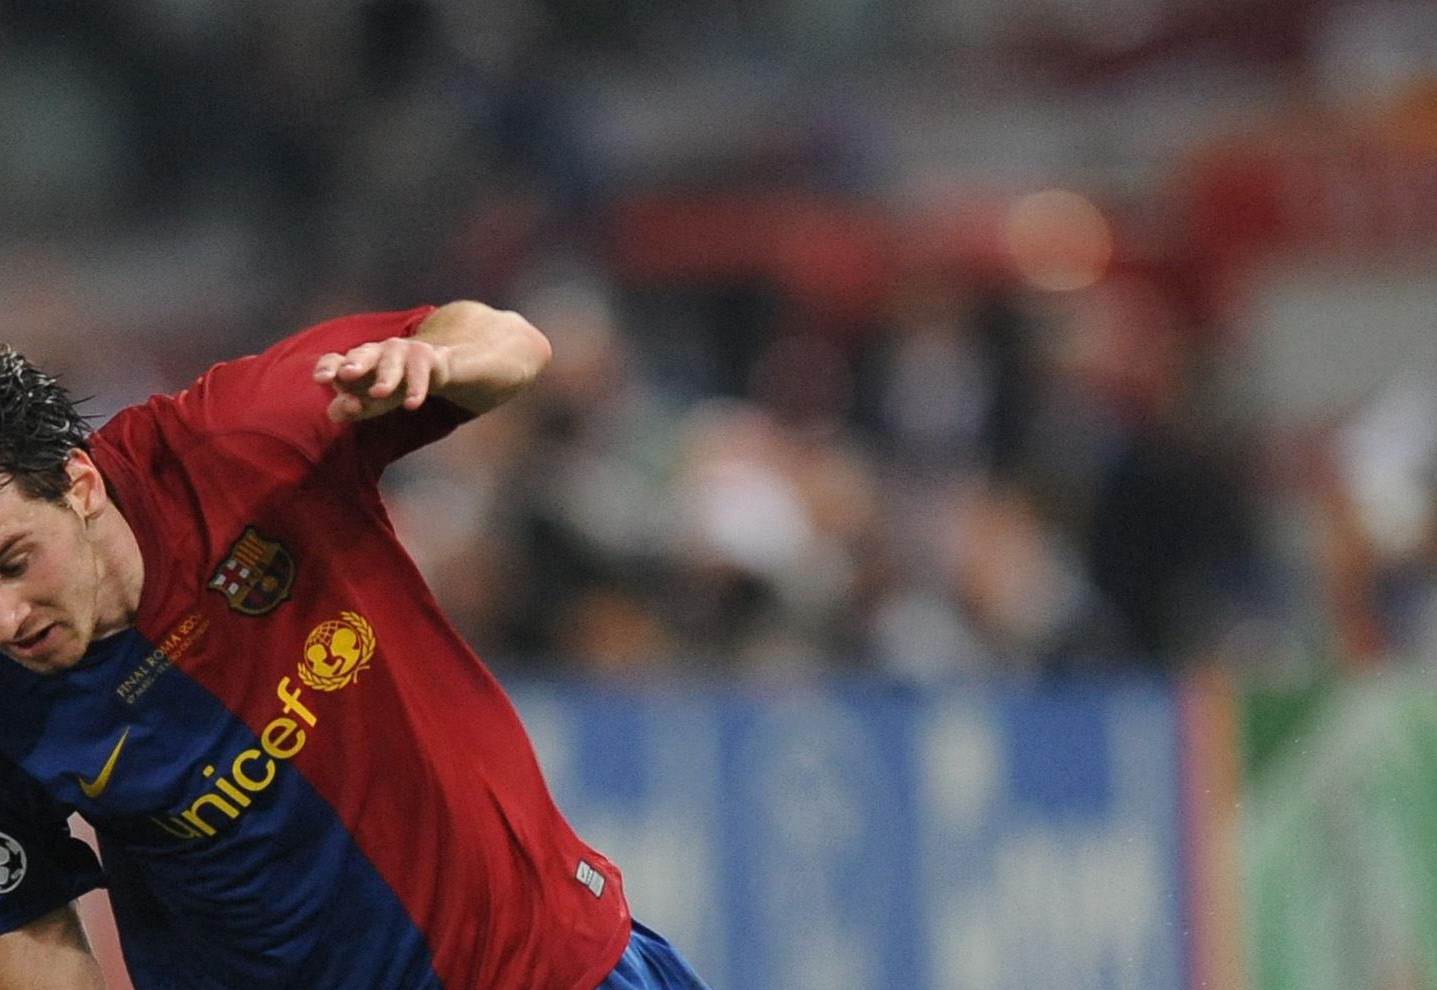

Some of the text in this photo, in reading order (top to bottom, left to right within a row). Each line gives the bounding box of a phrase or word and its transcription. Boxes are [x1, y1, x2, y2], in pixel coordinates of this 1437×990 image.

[116, 665, 149, 698] FINAL
[146, 634, 182, 667] ROMA
[151, 675, 318, 840] unicef
